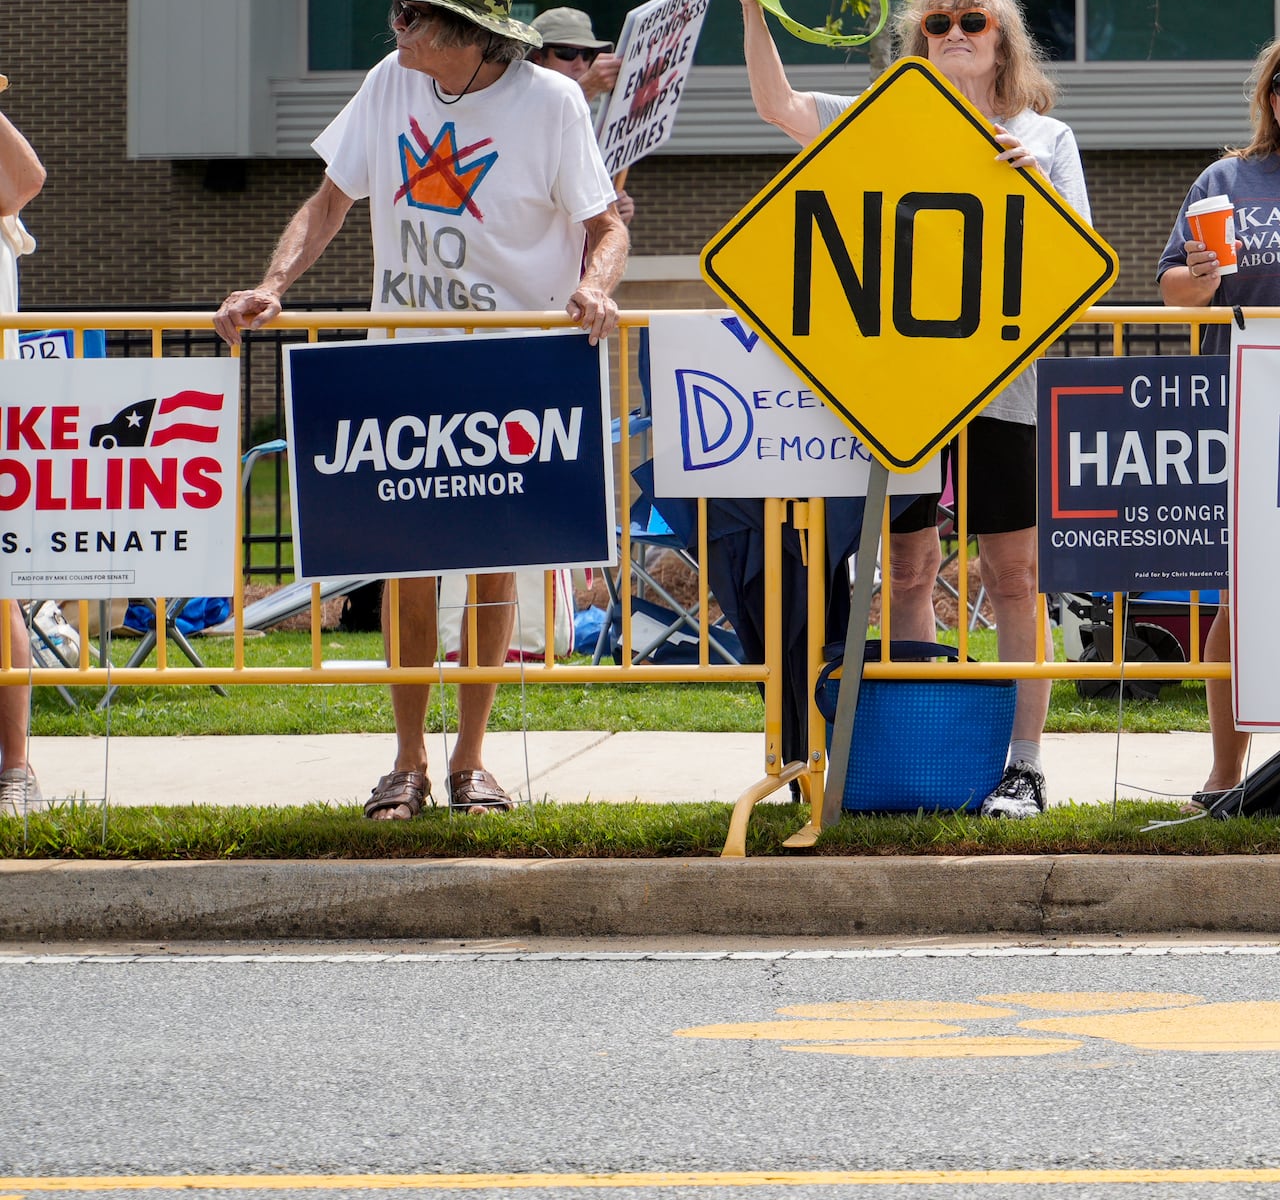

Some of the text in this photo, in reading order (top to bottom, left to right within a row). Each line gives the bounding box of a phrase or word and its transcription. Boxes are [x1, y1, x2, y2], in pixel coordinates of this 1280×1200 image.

[623, 35, 692, 101] ENABLE
[628, 39, 645, 61] IN
[605, 76, 684, 150] TRUMP'S
[604, 114, 668, 175] CRIMES
[401, 219, 466, 269] NO
[792, 190, 1025, 341] NO!
[381, 269, 496, 311] KINGS
[1130, 374, 1227, 408] CHRI
[0, 405, 79, 450] KE
[314, 407, 583, 475] JACKSON
[1069, 429, 1229, 487] HARD
[377, 472, 525, 501] GOVERNOR
[1125, 505, 1225, 522] US CONGR
[51, 530, 188, 553] SENATE
[1051, 529, 1214, 548] CONGRESSIONAL
